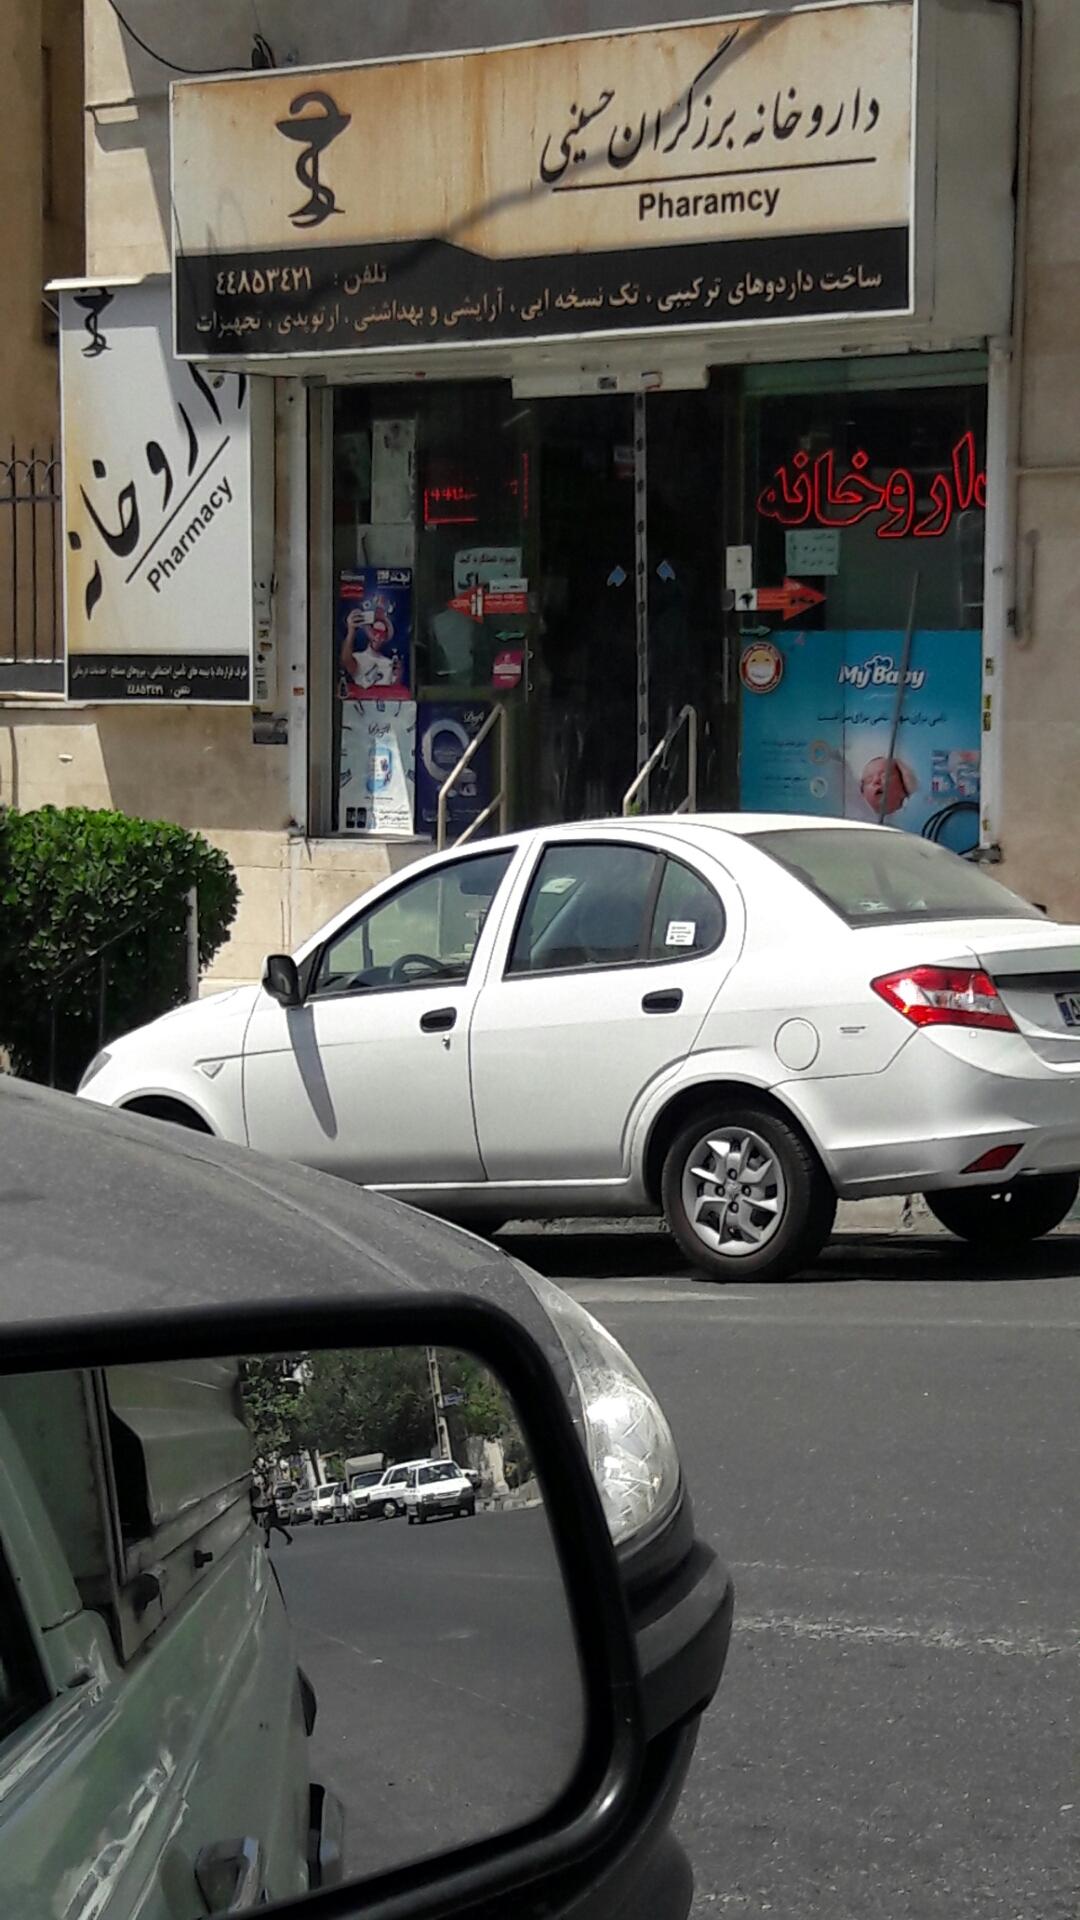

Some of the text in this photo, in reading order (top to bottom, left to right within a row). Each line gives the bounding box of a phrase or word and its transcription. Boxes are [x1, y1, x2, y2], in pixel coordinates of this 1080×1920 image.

[539, 27, 881, 184] داروخانه برزگران حسینی
[638, 187, 781, 221] Pharamcy
[818, 263, 882, 292] ساخت
[443, 285, 505, 327] آرایشی
[553, 286, 604, 310] نسخه
[608, 281, 641, 307] تک
[195, 309, 262, 339] تجهیزات
[429, 303, 439, 327] و
[145, 475, 235, 594] Pharmacy
